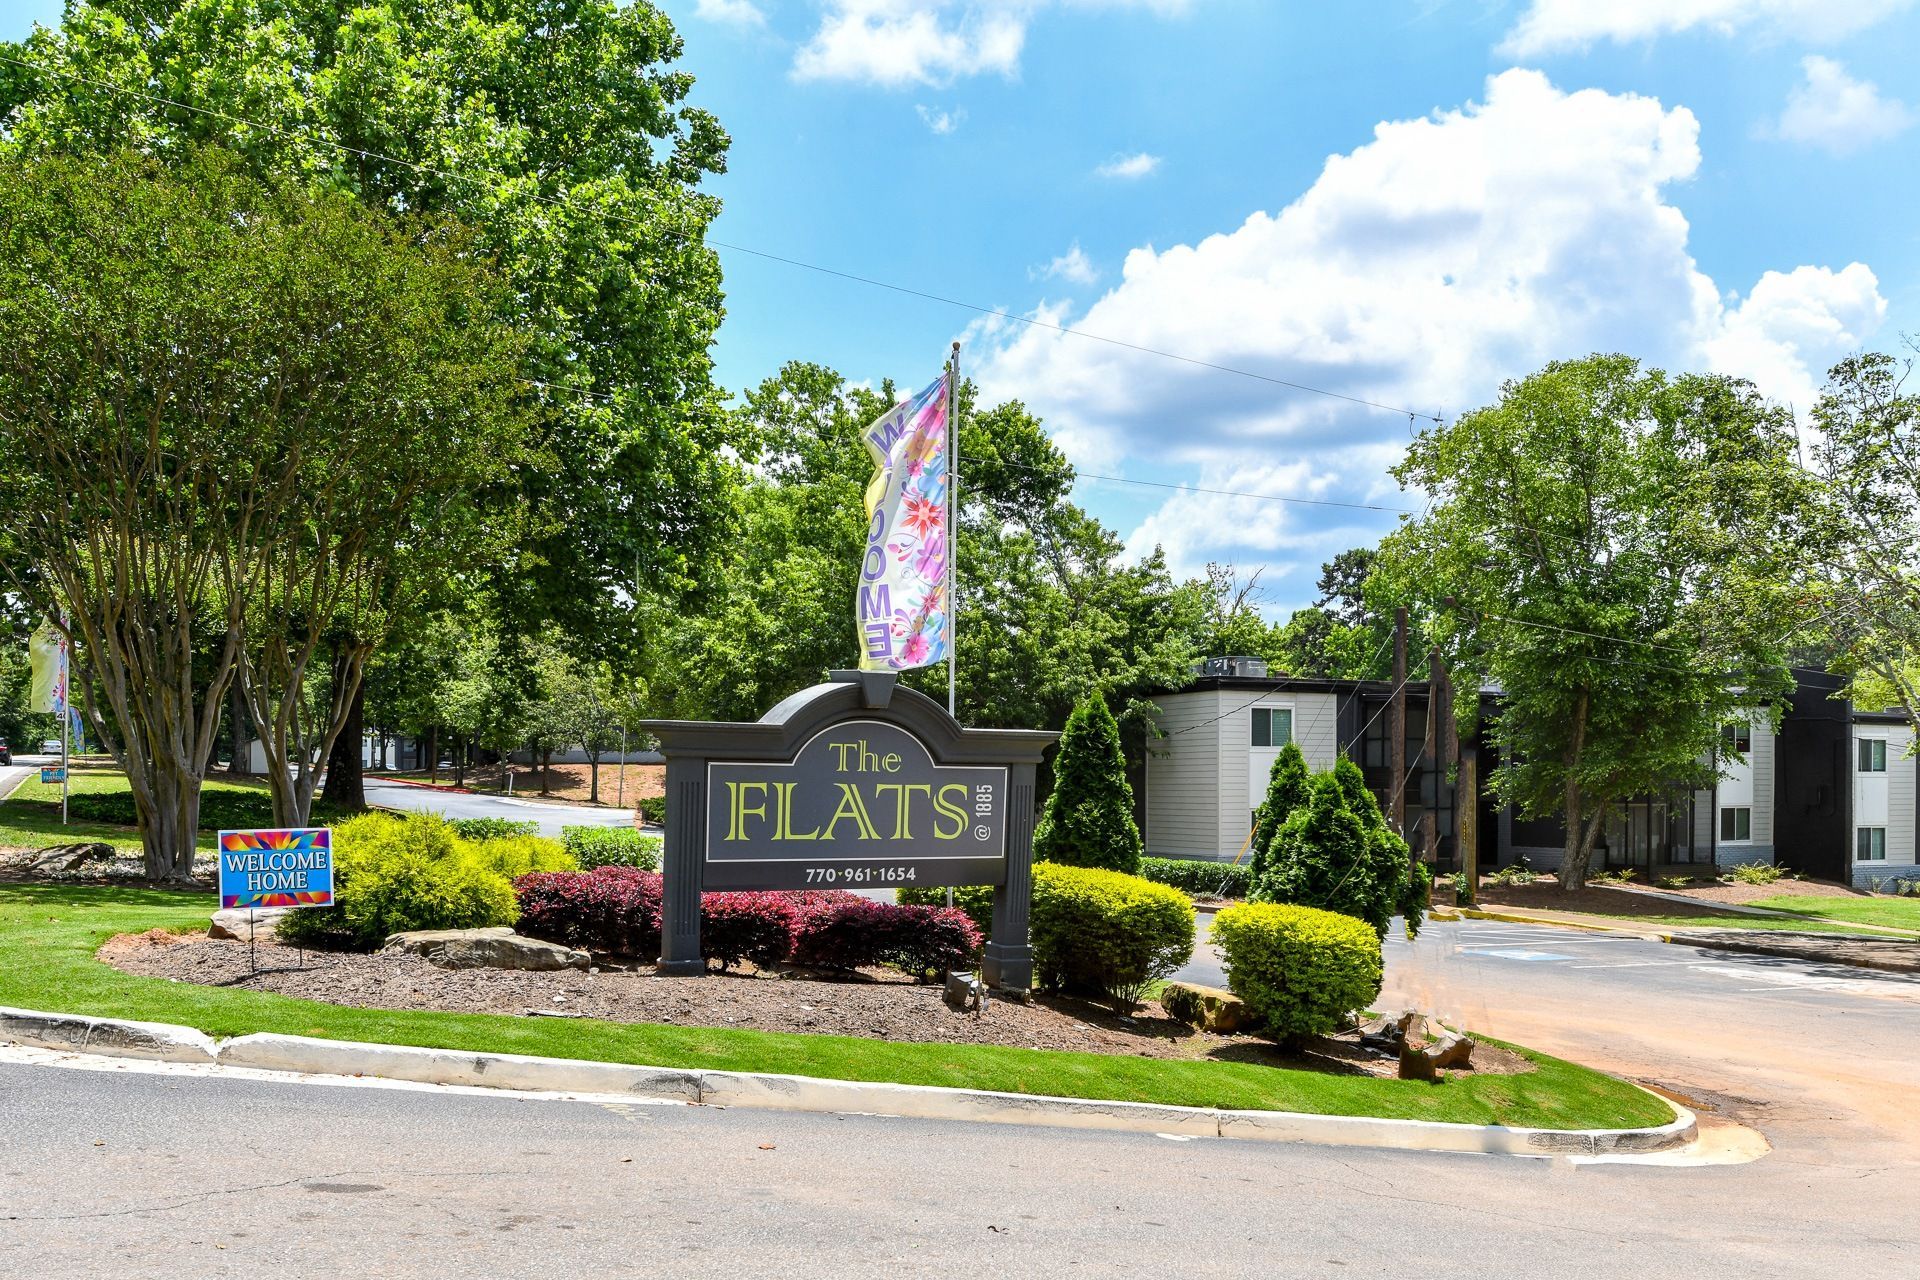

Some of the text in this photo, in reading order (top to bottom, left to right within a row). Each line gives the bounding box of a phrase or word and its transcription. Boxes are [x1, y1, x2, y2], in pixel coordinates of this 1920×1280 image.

[829, 739, 902, 773] The
[723, 781, 969, 841] FLATS
[974, 784, 993, 841] @ 1885
[225, 851, 327, 872] WELCOME
[247, 871, 309, 891] HOME
